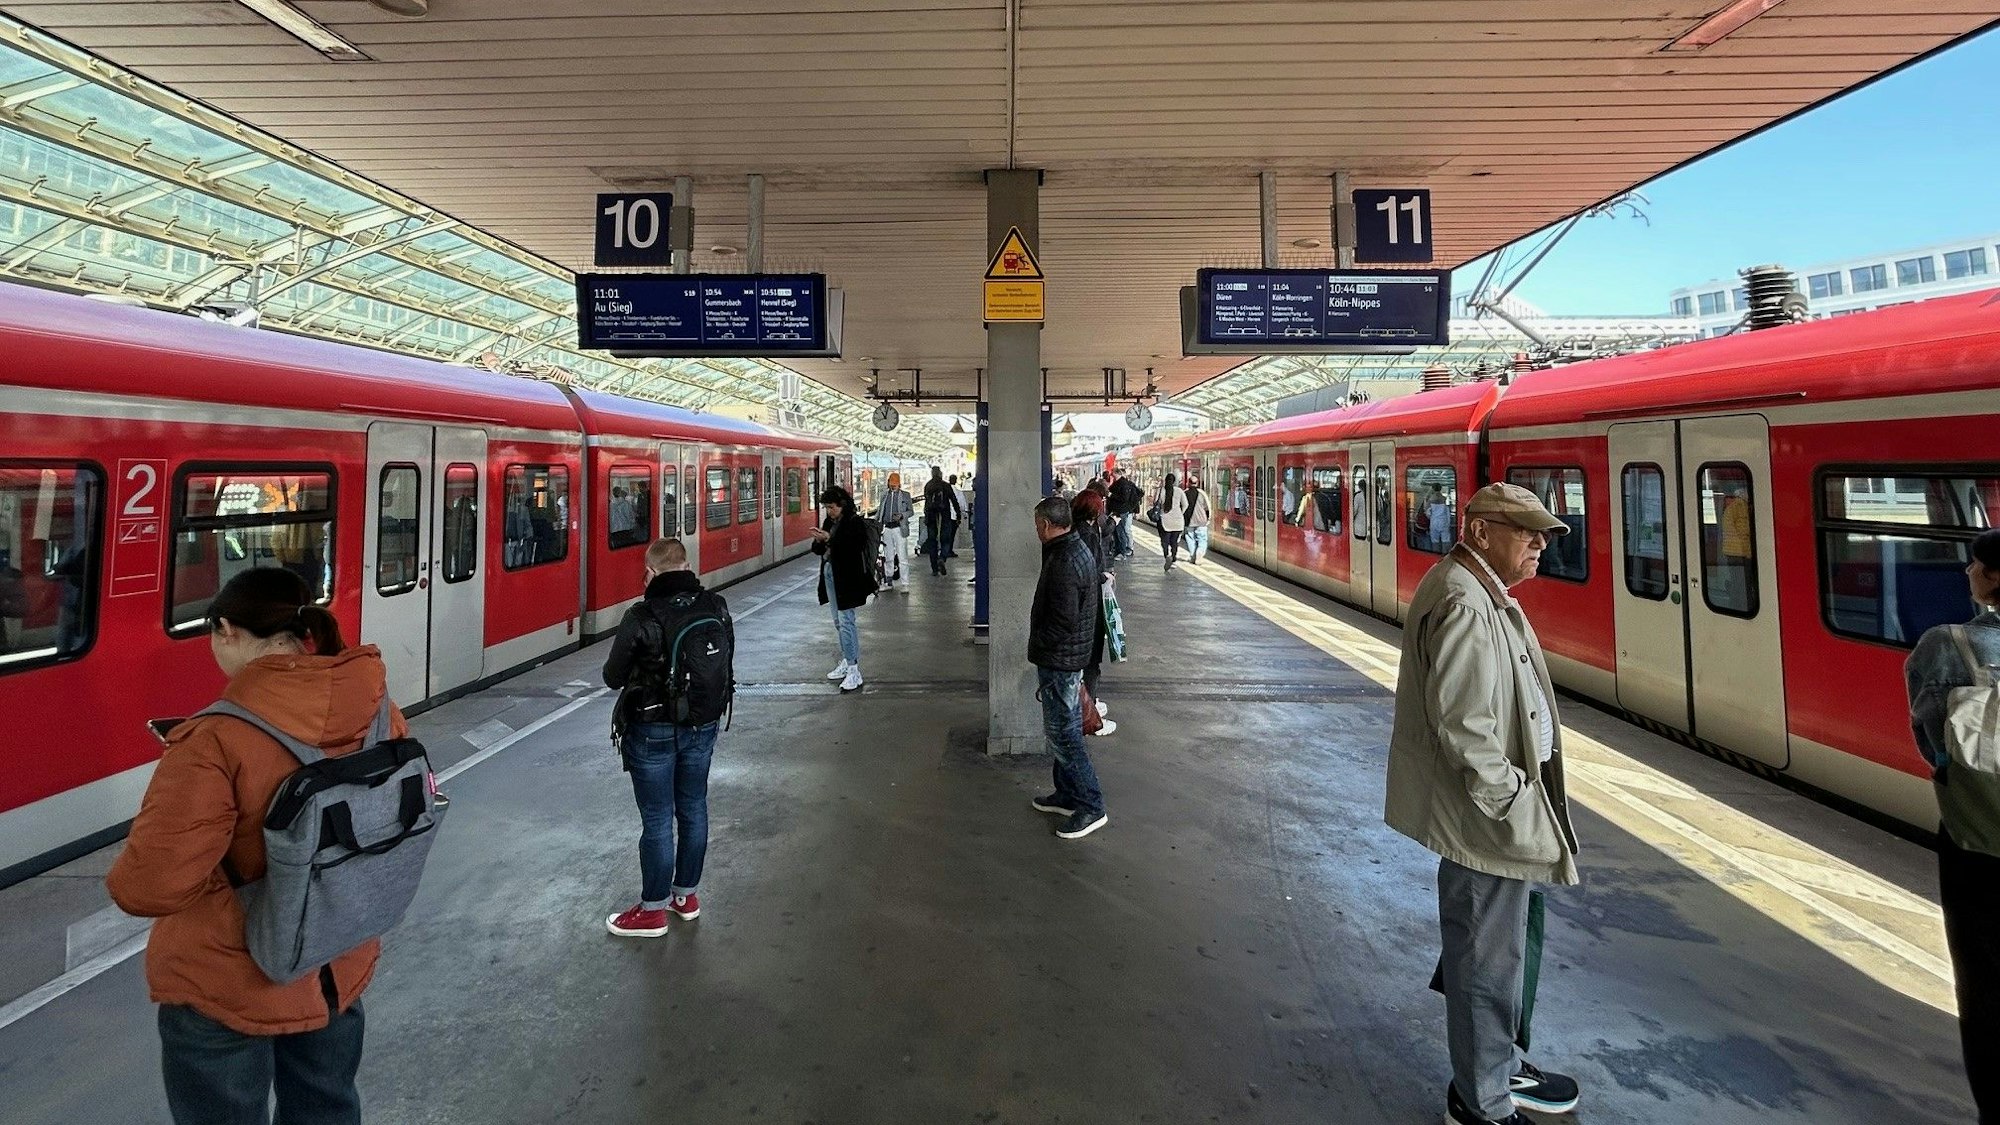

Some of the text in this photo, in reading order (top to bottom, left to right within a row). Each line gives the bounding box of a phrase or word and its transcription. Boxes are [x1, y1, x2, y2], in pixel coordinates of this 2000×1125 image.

[604, 199, 659, 248] 10
[1376, 196, 1422, 244] 11
[594, 288, 620, 298] 11:01
[1329, 284, 1355, 294] 10:44
[595, 301, 633, 314] Au (Sieg)
[1328, 297, 1380, 309] Köln-Nippes
[124, 464, 156, 515] 2
